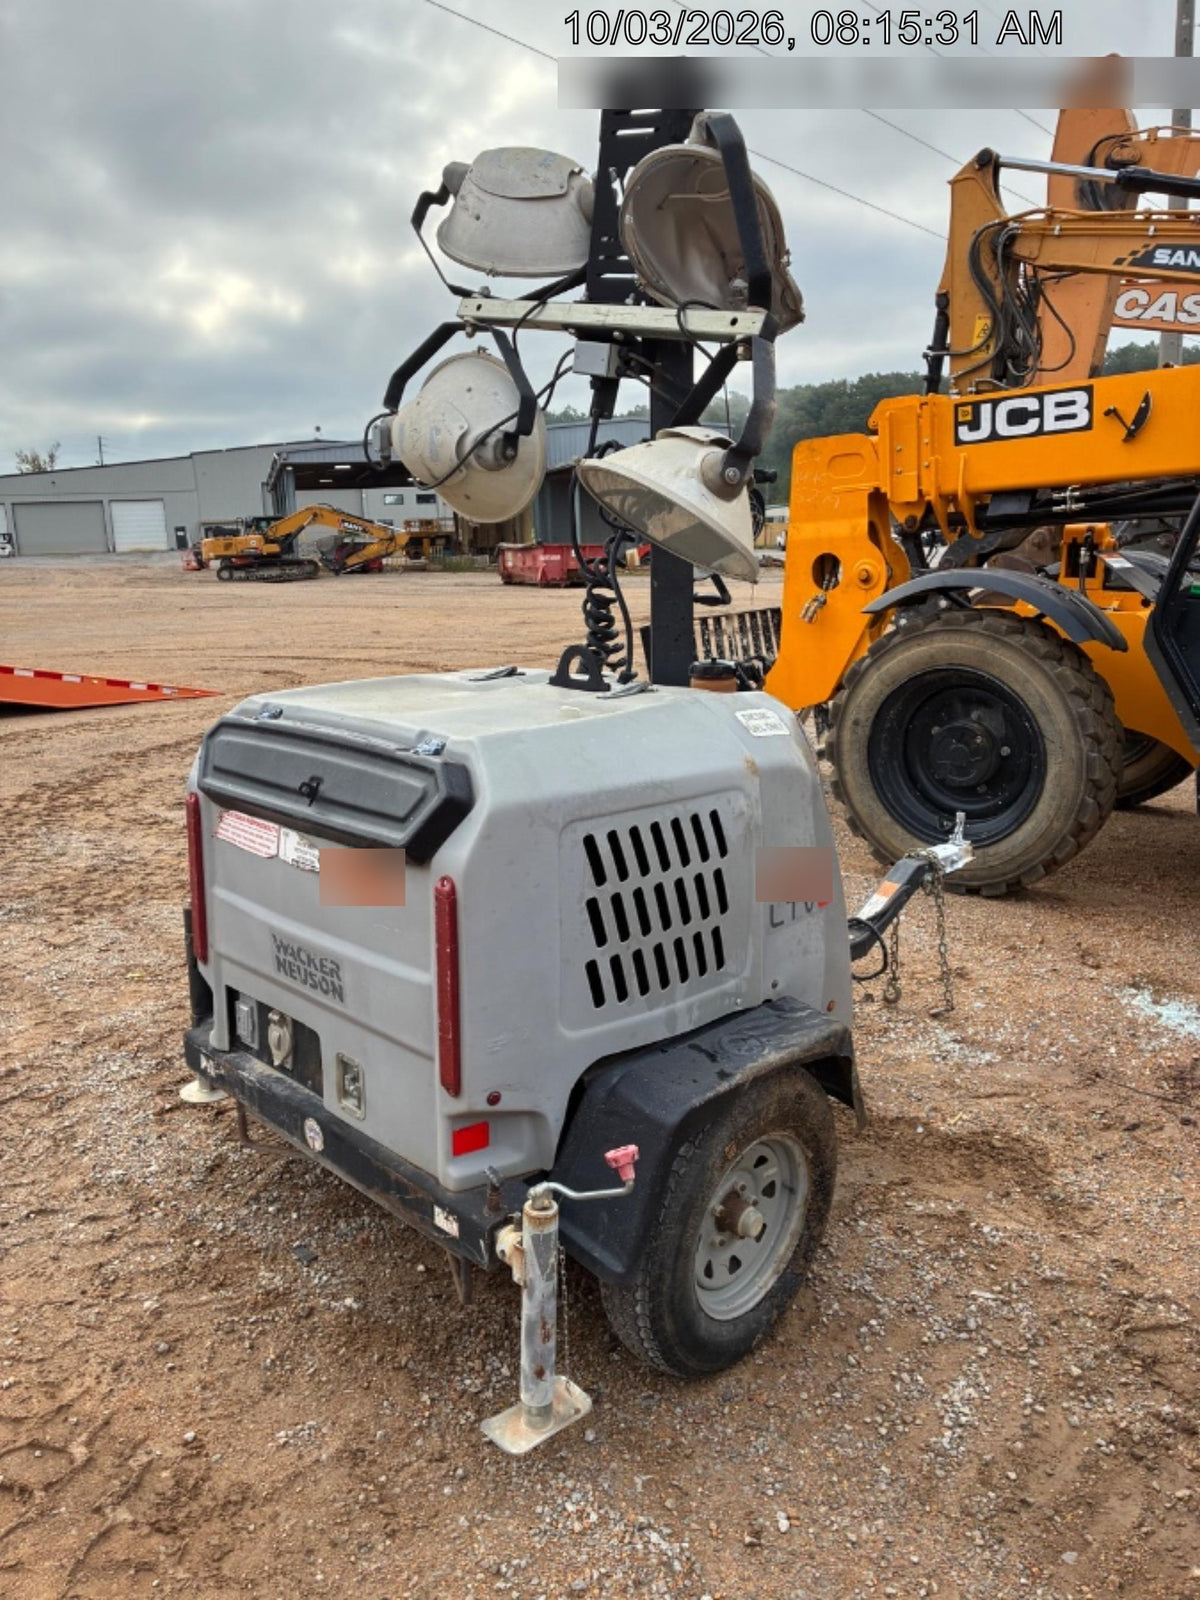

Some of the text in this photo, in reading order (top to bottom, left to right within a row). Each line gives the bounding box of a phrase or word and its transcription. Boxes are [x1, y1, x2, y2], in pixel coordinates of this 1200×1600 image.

[957, 390, 1090, 442] JCB
[272, 933, 342, 982] WACKER
[275, 954, 344, 1003] NEUSON
